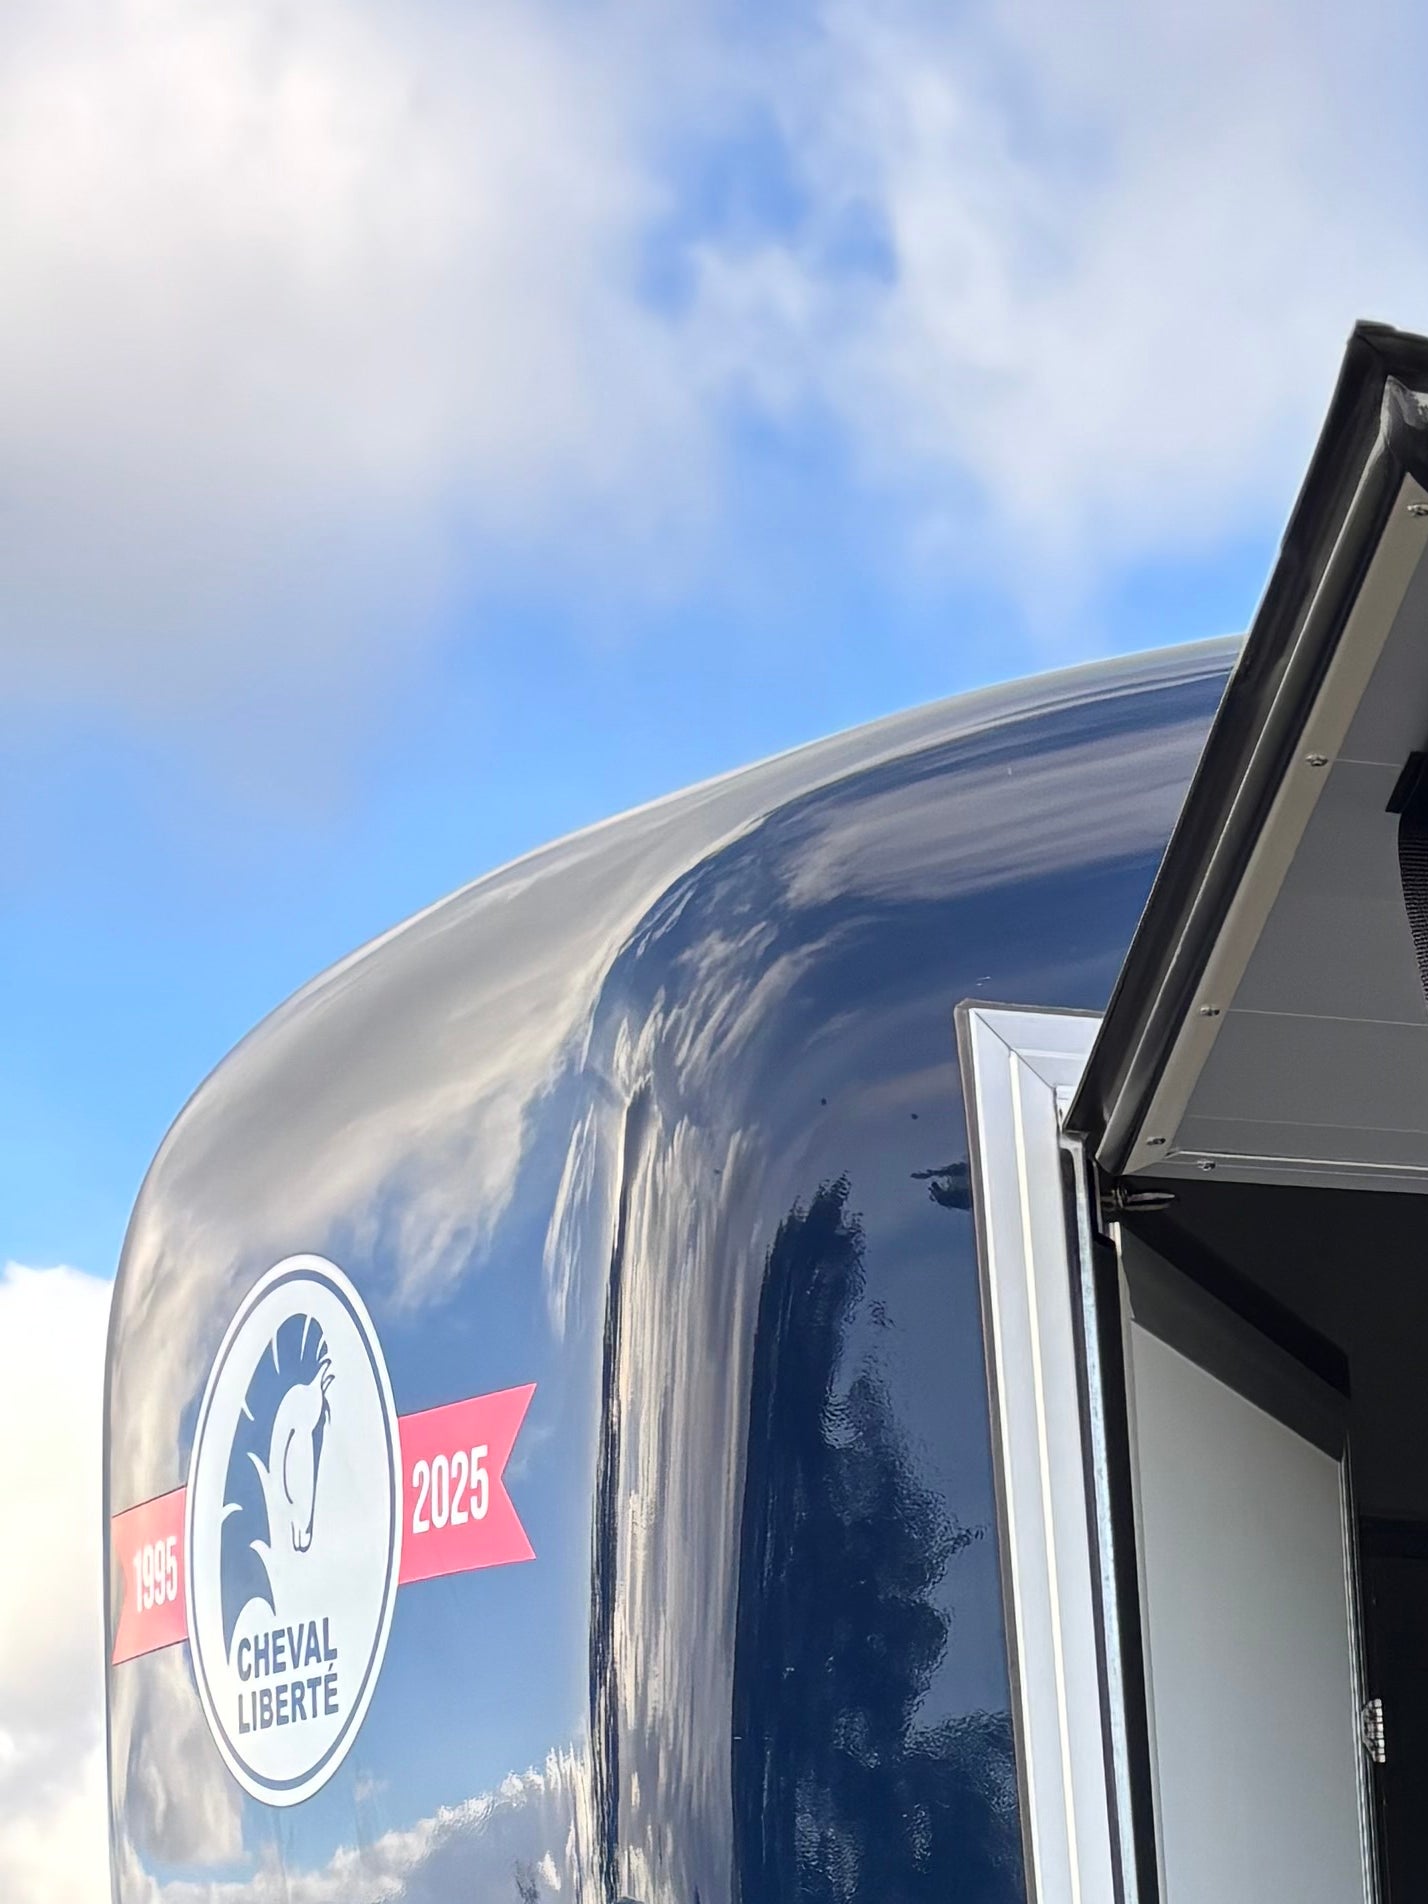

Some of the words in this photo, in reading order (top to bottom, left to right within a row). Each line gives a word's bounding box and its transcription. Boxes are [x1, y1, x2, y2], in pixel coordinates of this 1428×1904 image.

[411, 1446, 489, 1535] 2025
[133, 1535, 178, 1614] 1995
[237, 1616, 338, 1683] CHEVAL
[238, 1662, 340, 1735] LIBERTÉ
